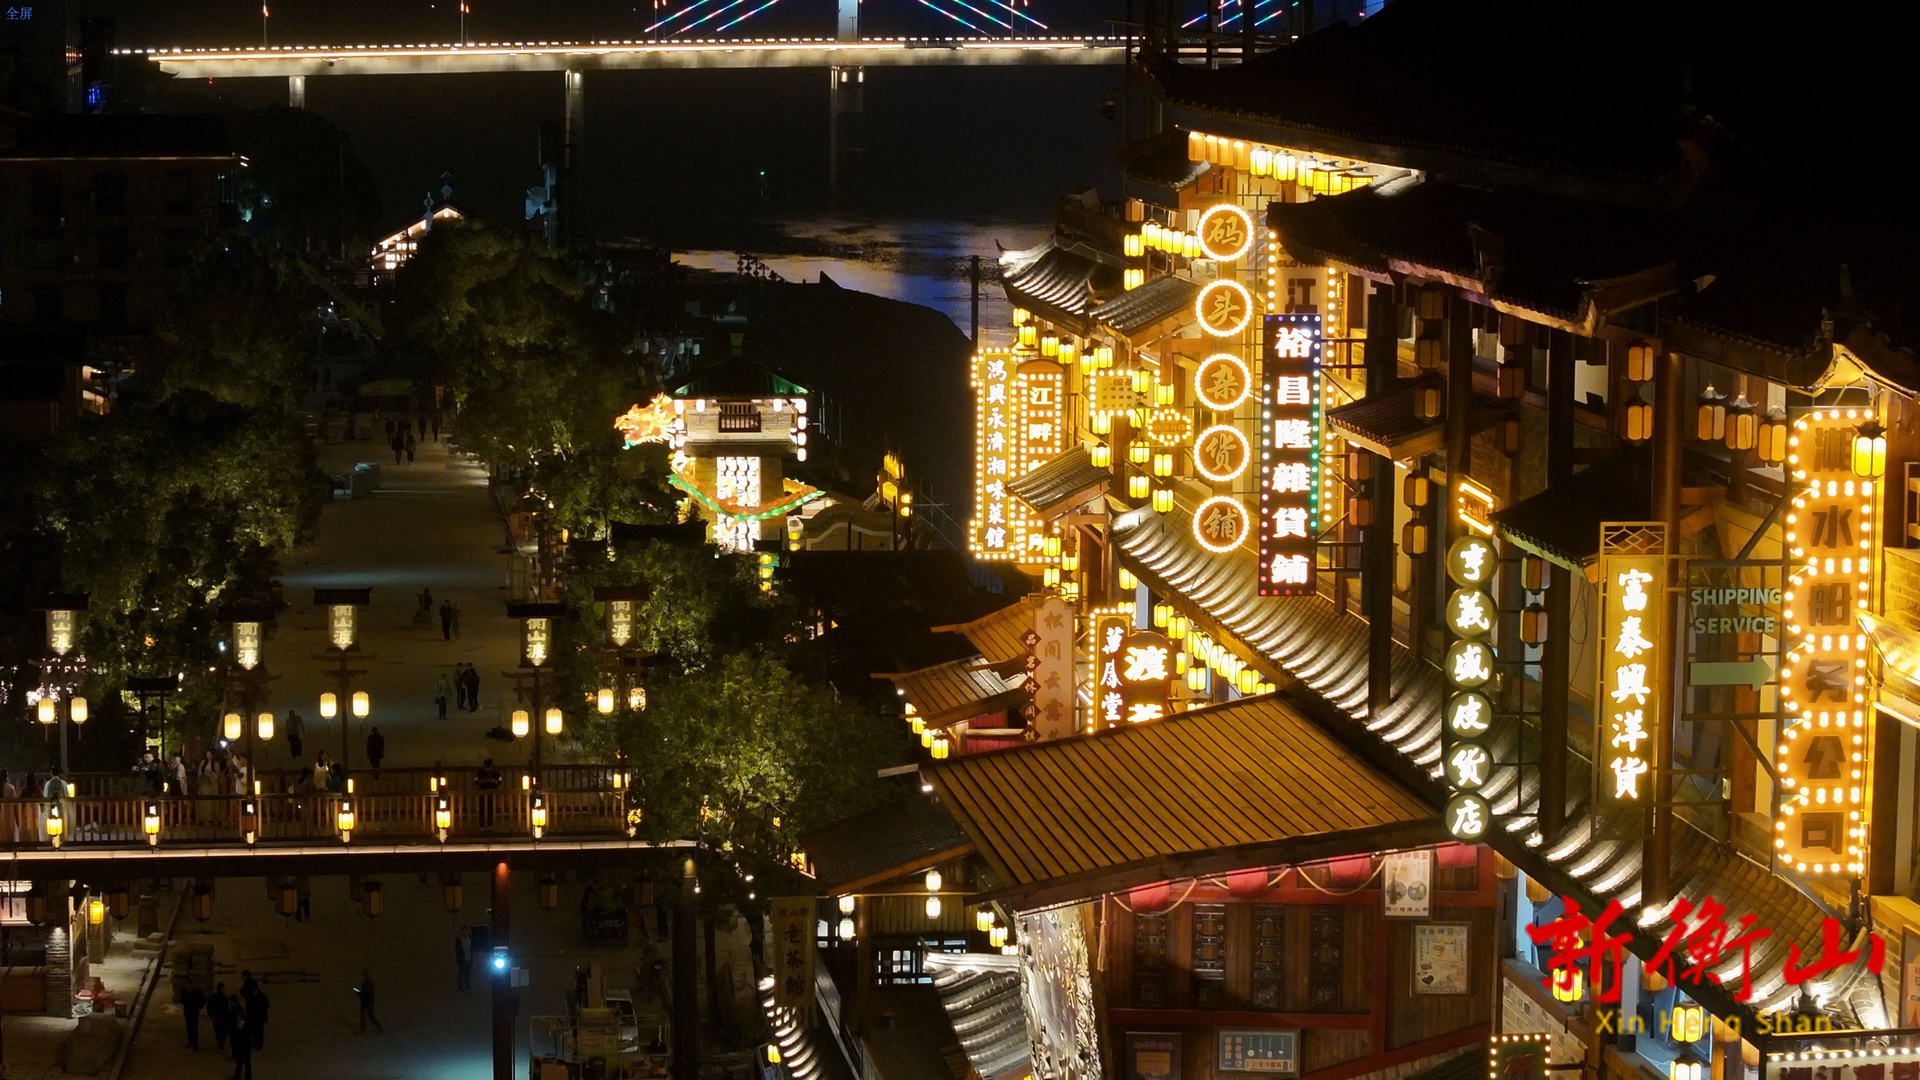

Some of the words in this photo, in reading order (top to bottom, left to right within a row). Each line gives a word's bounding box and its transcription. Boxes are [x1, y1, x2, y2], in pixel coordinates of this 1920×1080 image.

[1203, 216, 1245, 541] 码头杂货铺
[1691, 588, 1782, 605] SHIPPING
[1694, 616, 1775, 634] SERVICE
